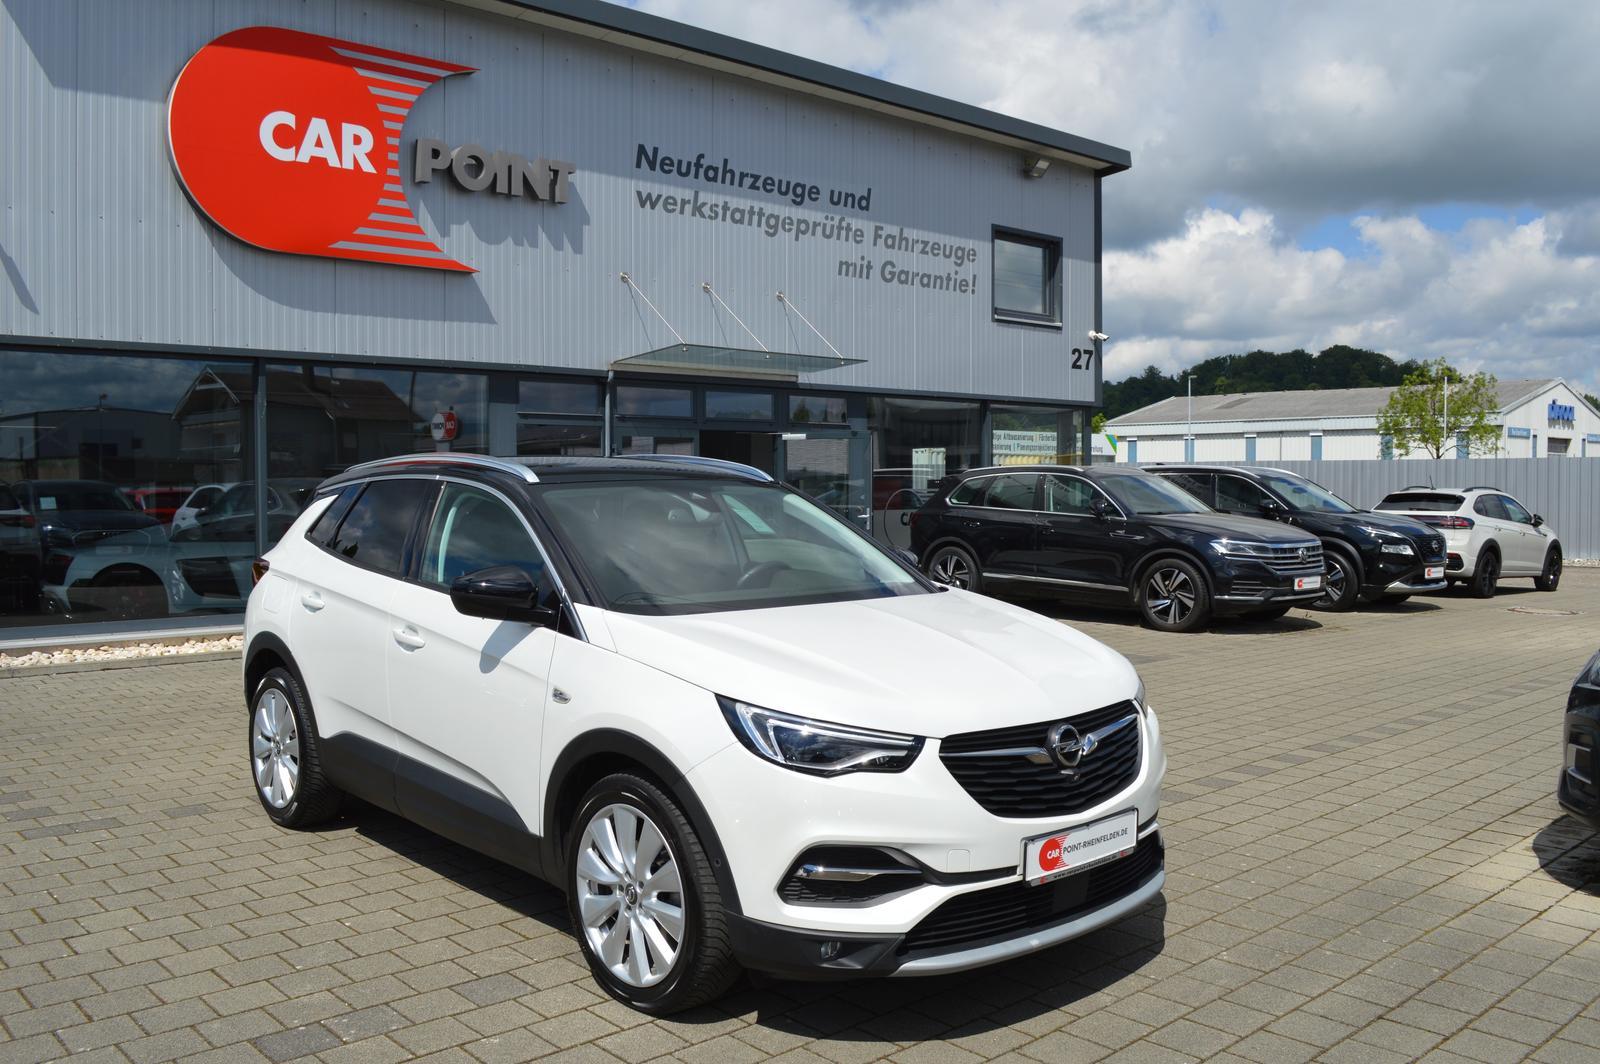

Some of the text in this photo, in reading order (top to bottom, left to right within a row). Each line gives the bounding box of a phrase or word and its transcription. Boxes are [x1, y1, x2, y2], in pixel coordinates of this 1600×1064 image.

[259, 110, 576, 204] CAR POINT
[635, 143, 872, 211] Neufahrzeuge und
[635, 189, 977, 267] werkstattgeprüfte Fahrzeuge
[838, 255, 976, 295] mit Garantie!
[1071, 348, 1093, 370] 27
[1047, 828, 1128, 859] CAR POINT-RHEINFELDEN.DE
